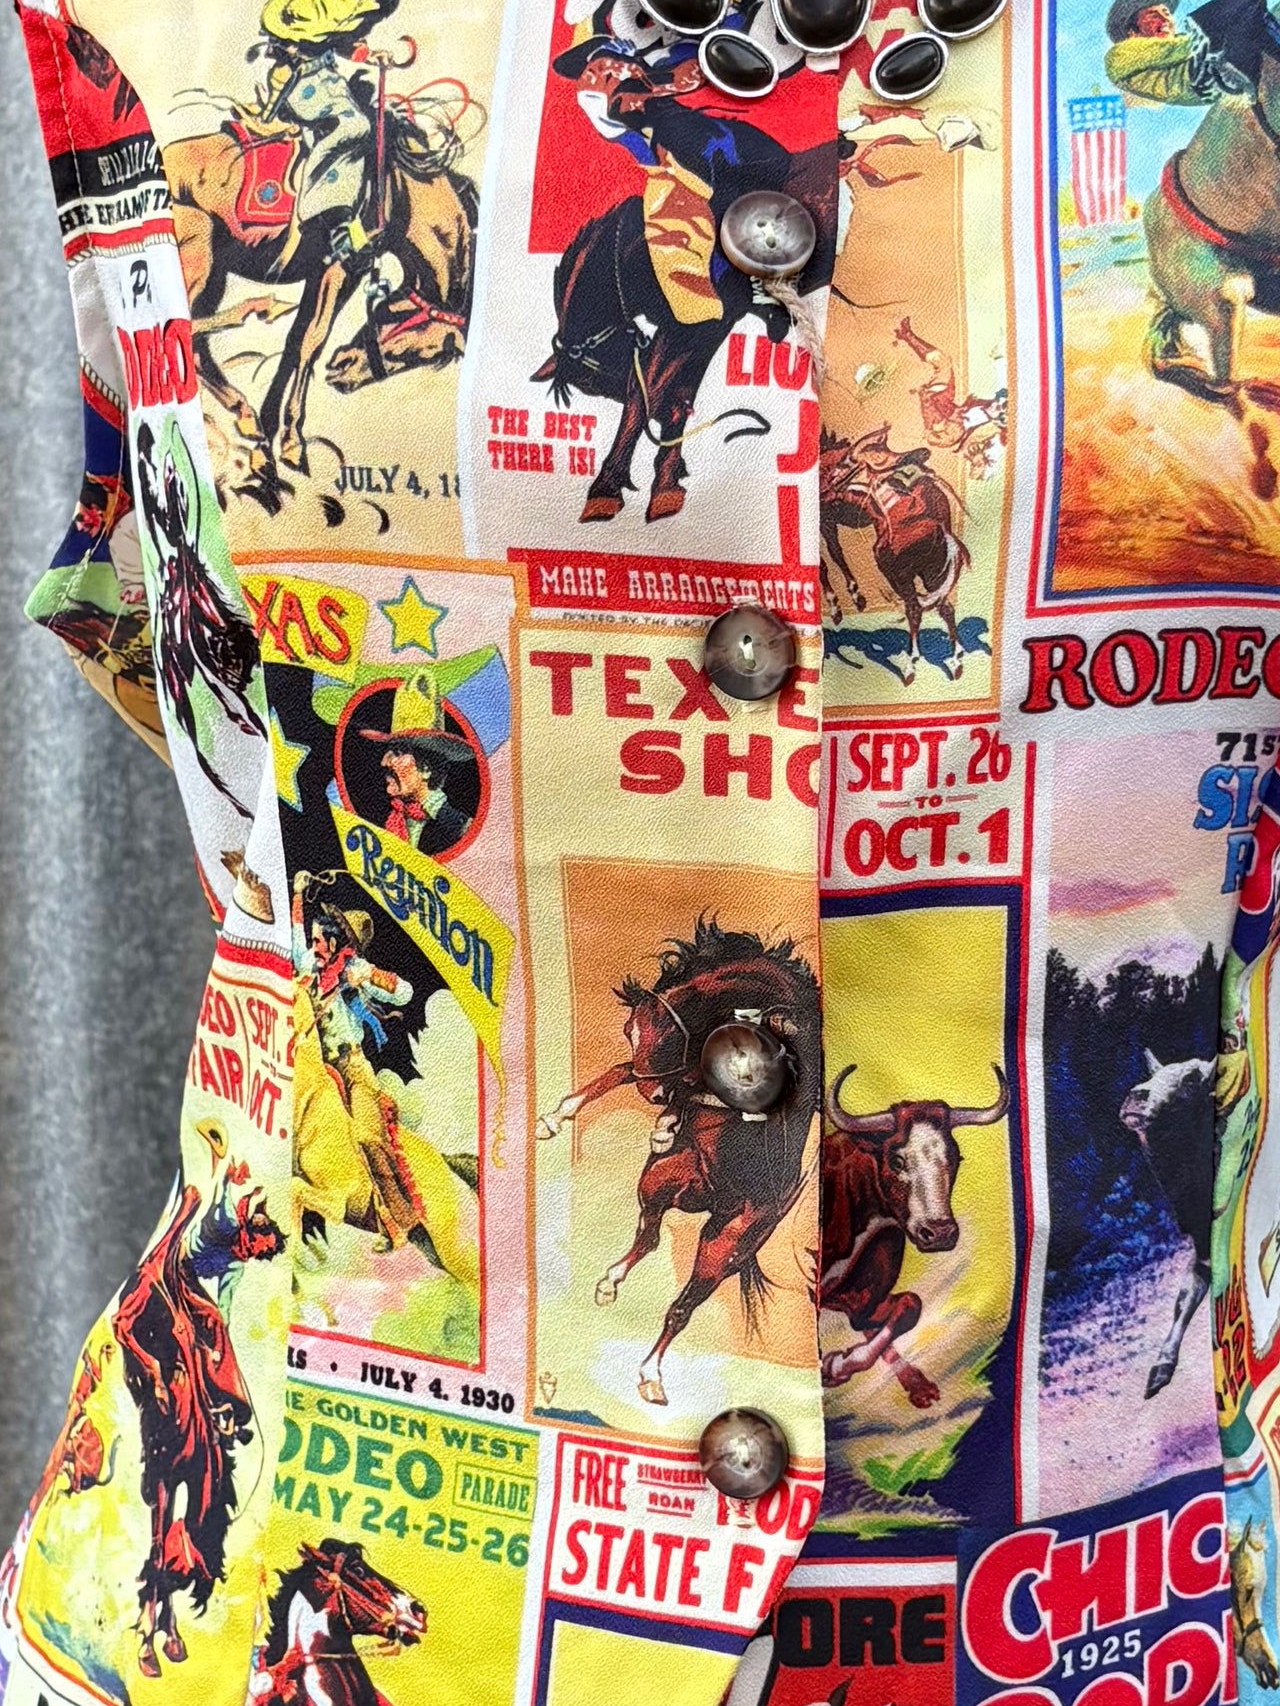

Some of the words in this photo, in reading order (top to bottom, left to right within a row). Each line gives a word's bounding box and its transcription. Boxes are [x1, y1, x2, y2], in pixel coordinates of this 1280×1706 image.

[487, 405, 529, 437] THE
[543, 410, 598, 442] BEST
[334, 463, 400, 496] JULY
[406, 470, 431, 500] 4,
[487, 439, 555, 474] THERE
[539, 565, 609, 599] MAKE
[847, 730, 957, 793] SEPT.
[966, 727, 1013, 785] 26
[914, 794, 944, 809] TO
[843, 811, 971, 877] OCT.
[977, 807, 1010, 865] 1
[345, 824, 499, 1008] Reunion
[192, 1037, 244, 1109] AIR
[360, 1361, 417, 1394] JULY
[461, 1383, 516, 1414] 1930
[316, 1398, 428, 1442] GOLDEN
[440, 1425, 531, 1464] WEST
[460, 1471, 531, 1514] PARADE
[571, 1447, 631, 1513] FREE
[648, 1491, 697, 1512] ROAN
[360, 1496, 530, 1568] 24-25-26
[560, 1518, 711, 1609] STATE
[961, 1491, 1232, 1685] CHIC
[1060, 1629, 1142, 1680] 1925
